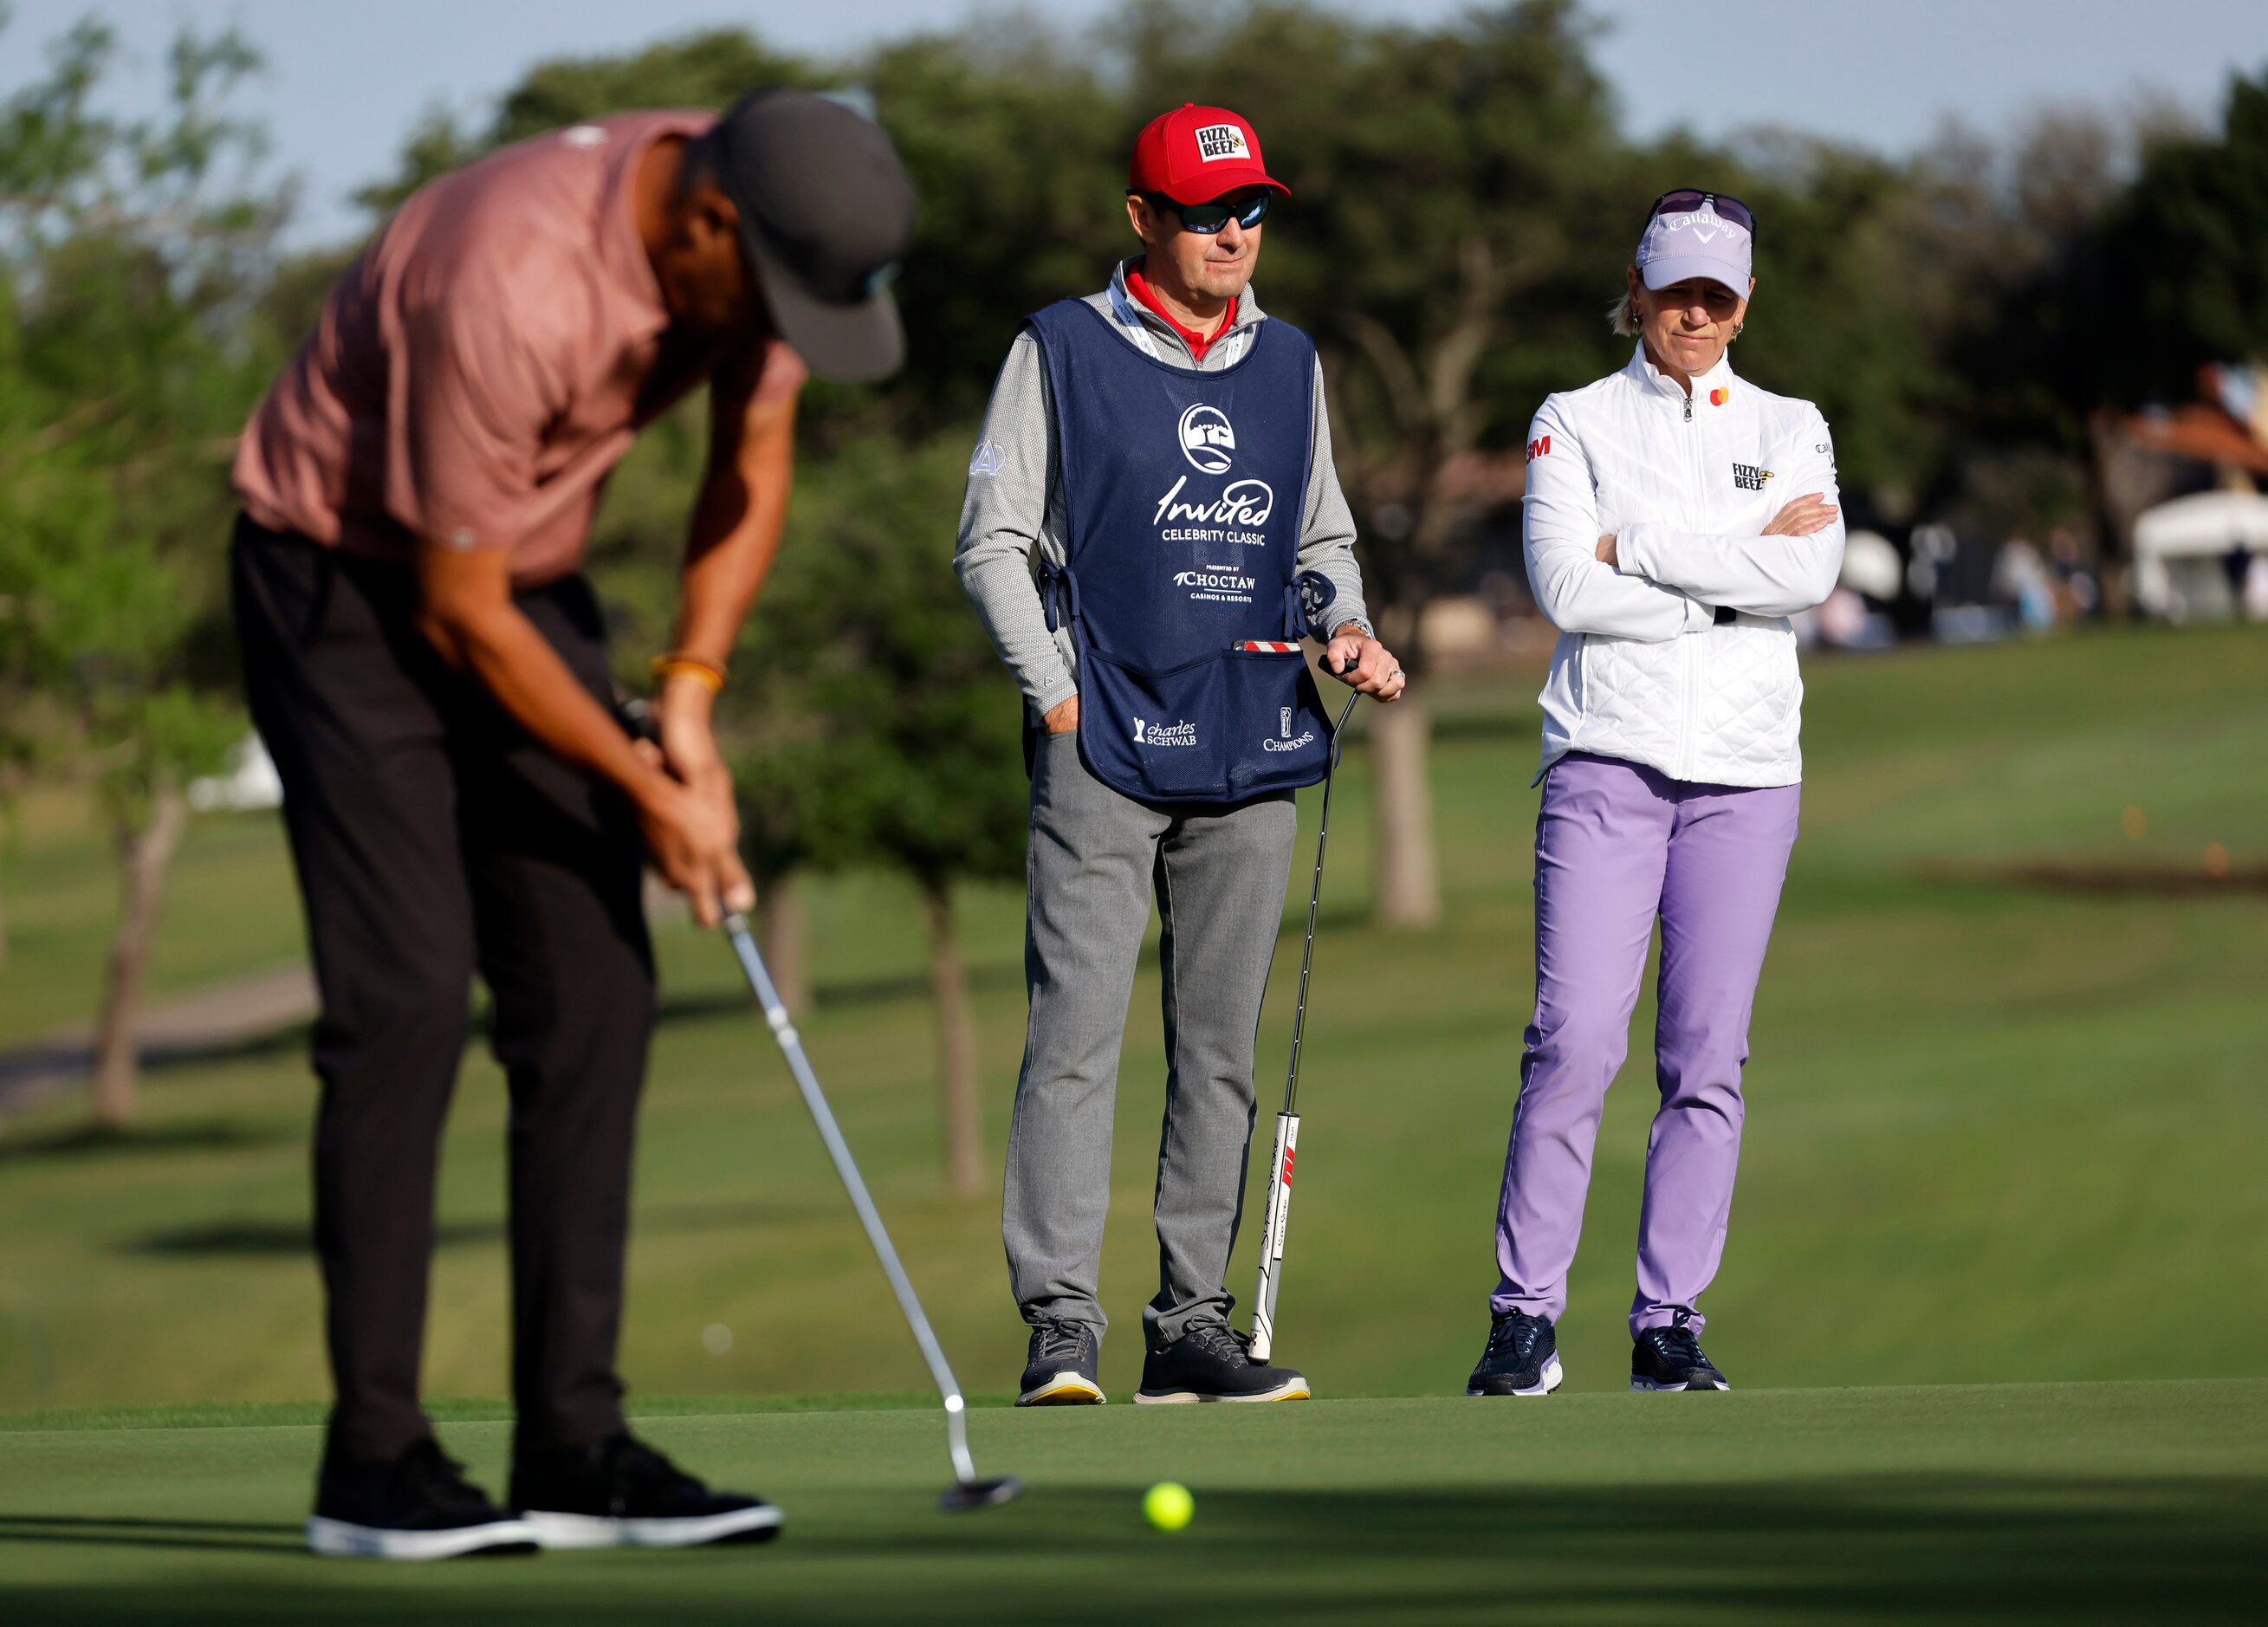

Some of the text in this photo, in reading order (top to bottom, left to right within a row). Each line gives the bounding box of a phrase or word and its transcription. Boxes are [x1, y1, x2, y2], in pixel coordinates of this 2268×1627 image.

[1198, 126, 1230, 144] FIZZY
[1202, 140, 1235, 157] BEEZ
[1669, 211, 1736, 239] Callaway
[1733, 462, 1759, 479] FIZZY
[1734, 475, 1763, 491] BEEZ
[1153, 475, 1273, 527] Invited
[1162, 528, 1266, 546] CELEBRITY CLASSIC
[1183, 571, 1255, 590] CHOCTAW
[1190, 593, 1220, 601] CASINOS
[1147, 719, 1196, 736] charles
[1147, 735, 1196, 746] SCHWAB
[1263, 731, 1314, 751] CHAMPIONS
